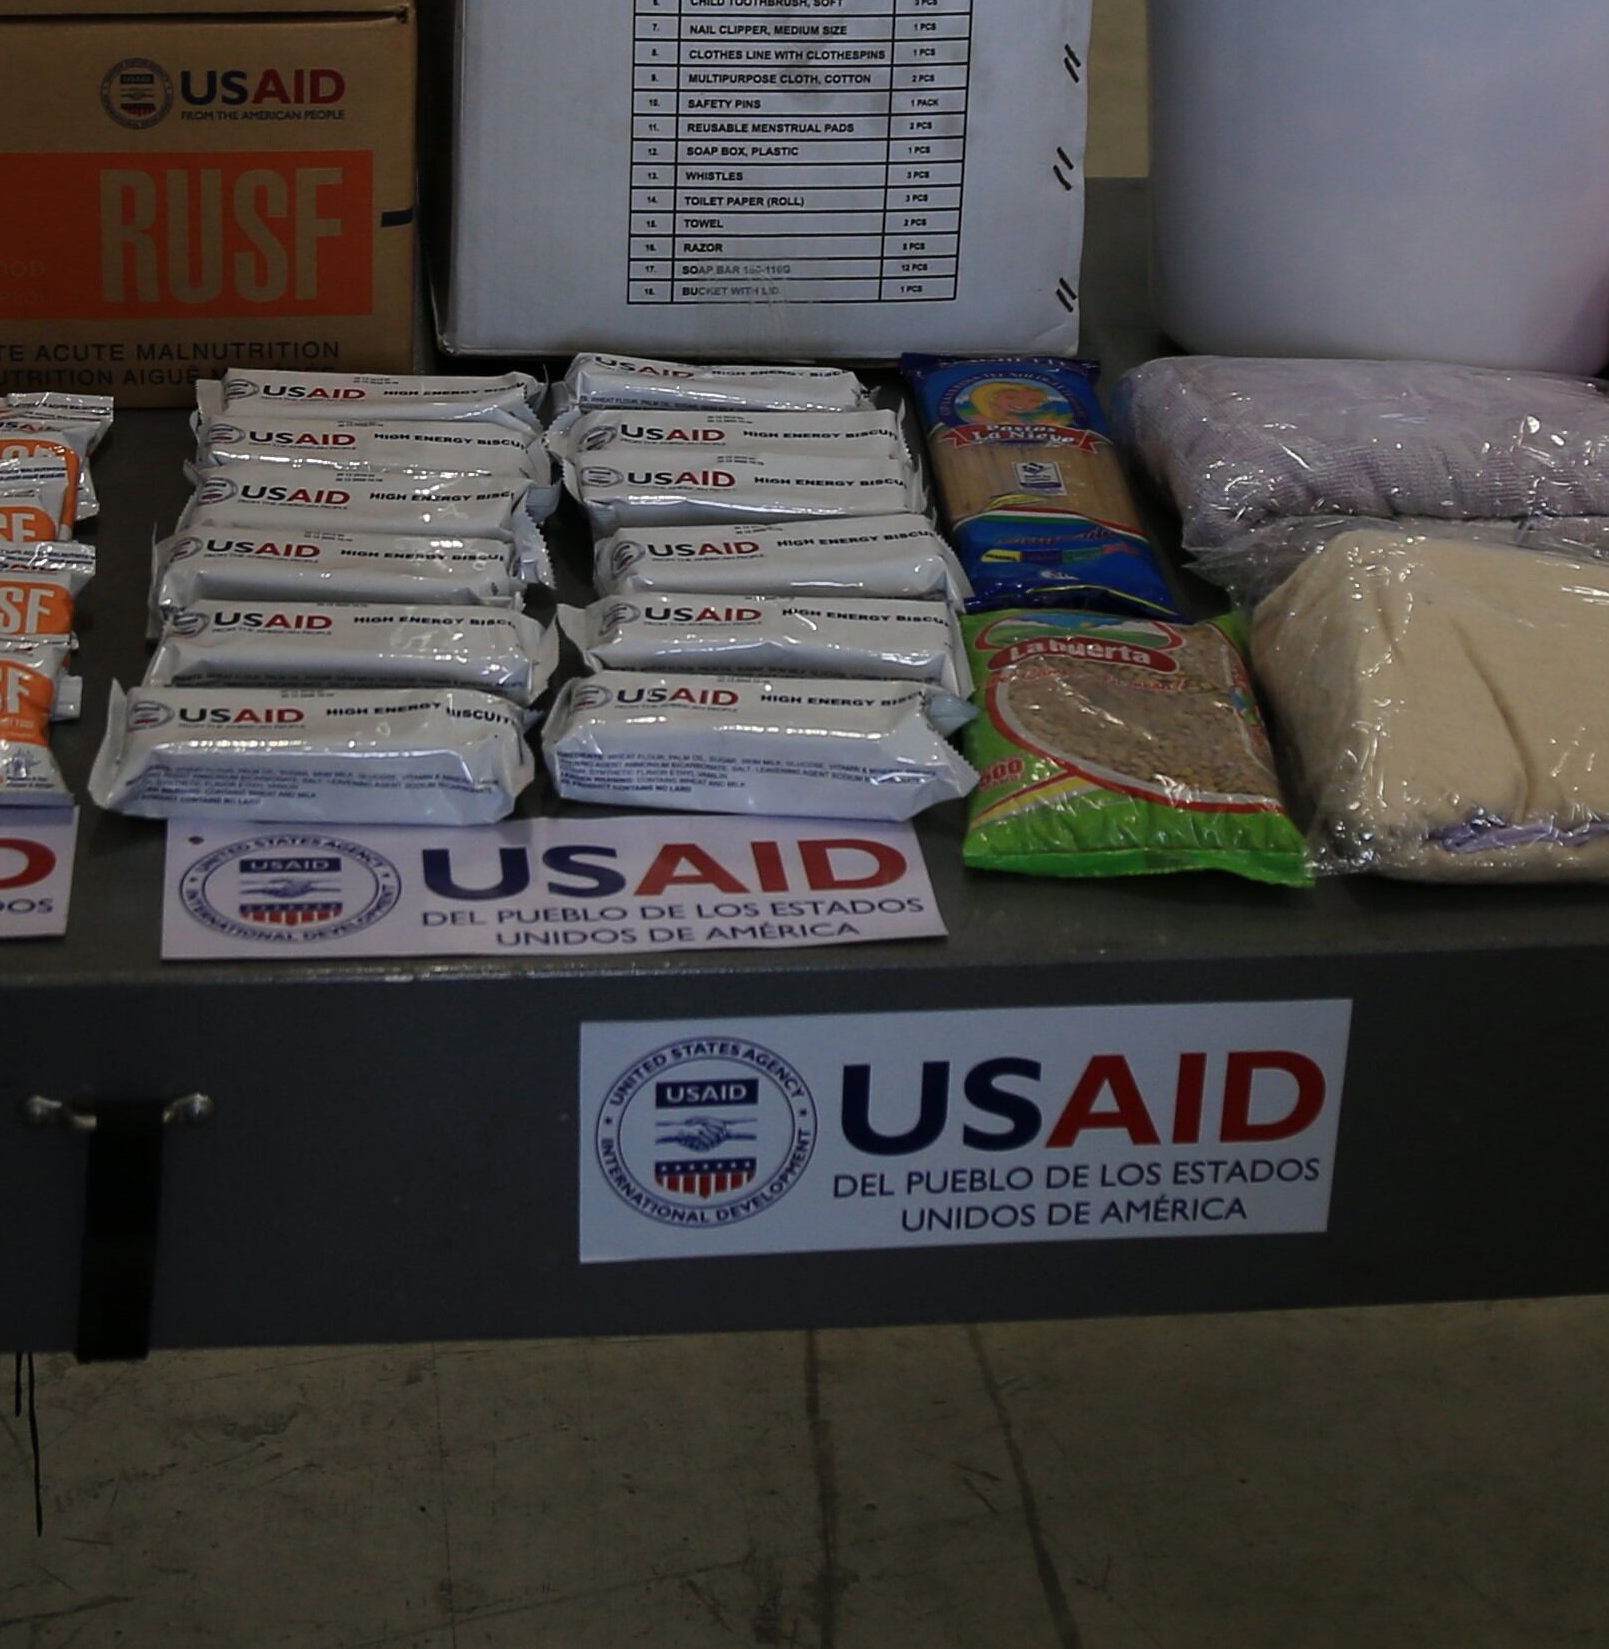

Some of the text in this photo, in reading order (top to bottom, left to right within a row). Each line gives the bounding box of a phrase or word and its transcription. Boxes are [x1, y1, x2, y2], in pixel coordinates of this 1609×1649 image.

[688, 49, 885, 62] CLOTHES LINE WITH CLOTHESPINS
[181, 69, 345, 105] USAID
[688, 73, 871, 85] MULTIPURPOSE CLOTH, COTTON
[686, 122, 854, 133] REUSABLE MENSTRUAL PADS
[685, 171, 743, 181] WHISTLES
[683, 218, 724, 228] TOWEL
[101, 168, 344, 304] RUSF
[683, 242, 723, 252] RAZOR
[29, 342, 125, 365] ACUTE
[136, 340, 339, 365] MALNUTRITION
[250, 431, 355, 446] USAID
[620, 424, 725, 441] USAID
[242, 486, 350, 505] USAID
[208, 540, 320, 558] USAID
[647, 541, 760, 557] USAID
[1011, 640, 1151, 664] La huerta
[618, 689, 738, 705] USAID
[179, 708, 304, 724] USAID
[249, 859, 331, 872] USAID
[421, 840, 908, 899] USAID
[421, 897, 924, 927] DEL PUEBLO DE LOS ESTADOS
[496, 918, 862, 947] UNIDOS DE AMÉRICA
[610, 1041, 806, 1107] UNITED STATES AGENCY
[664, 1083, 749, 1104] USAID
[841, 1051, 1327, 1156] USAID
[600, 1128, 812, 1224] INTERNATIONAL DEVELOPMENT
[833, 1155, 1320, 1198] DEL PUEBLO DE LOS ESTADOS
[901, 1191, 1247, 1232] UNIDOS DE AMÉRICA
